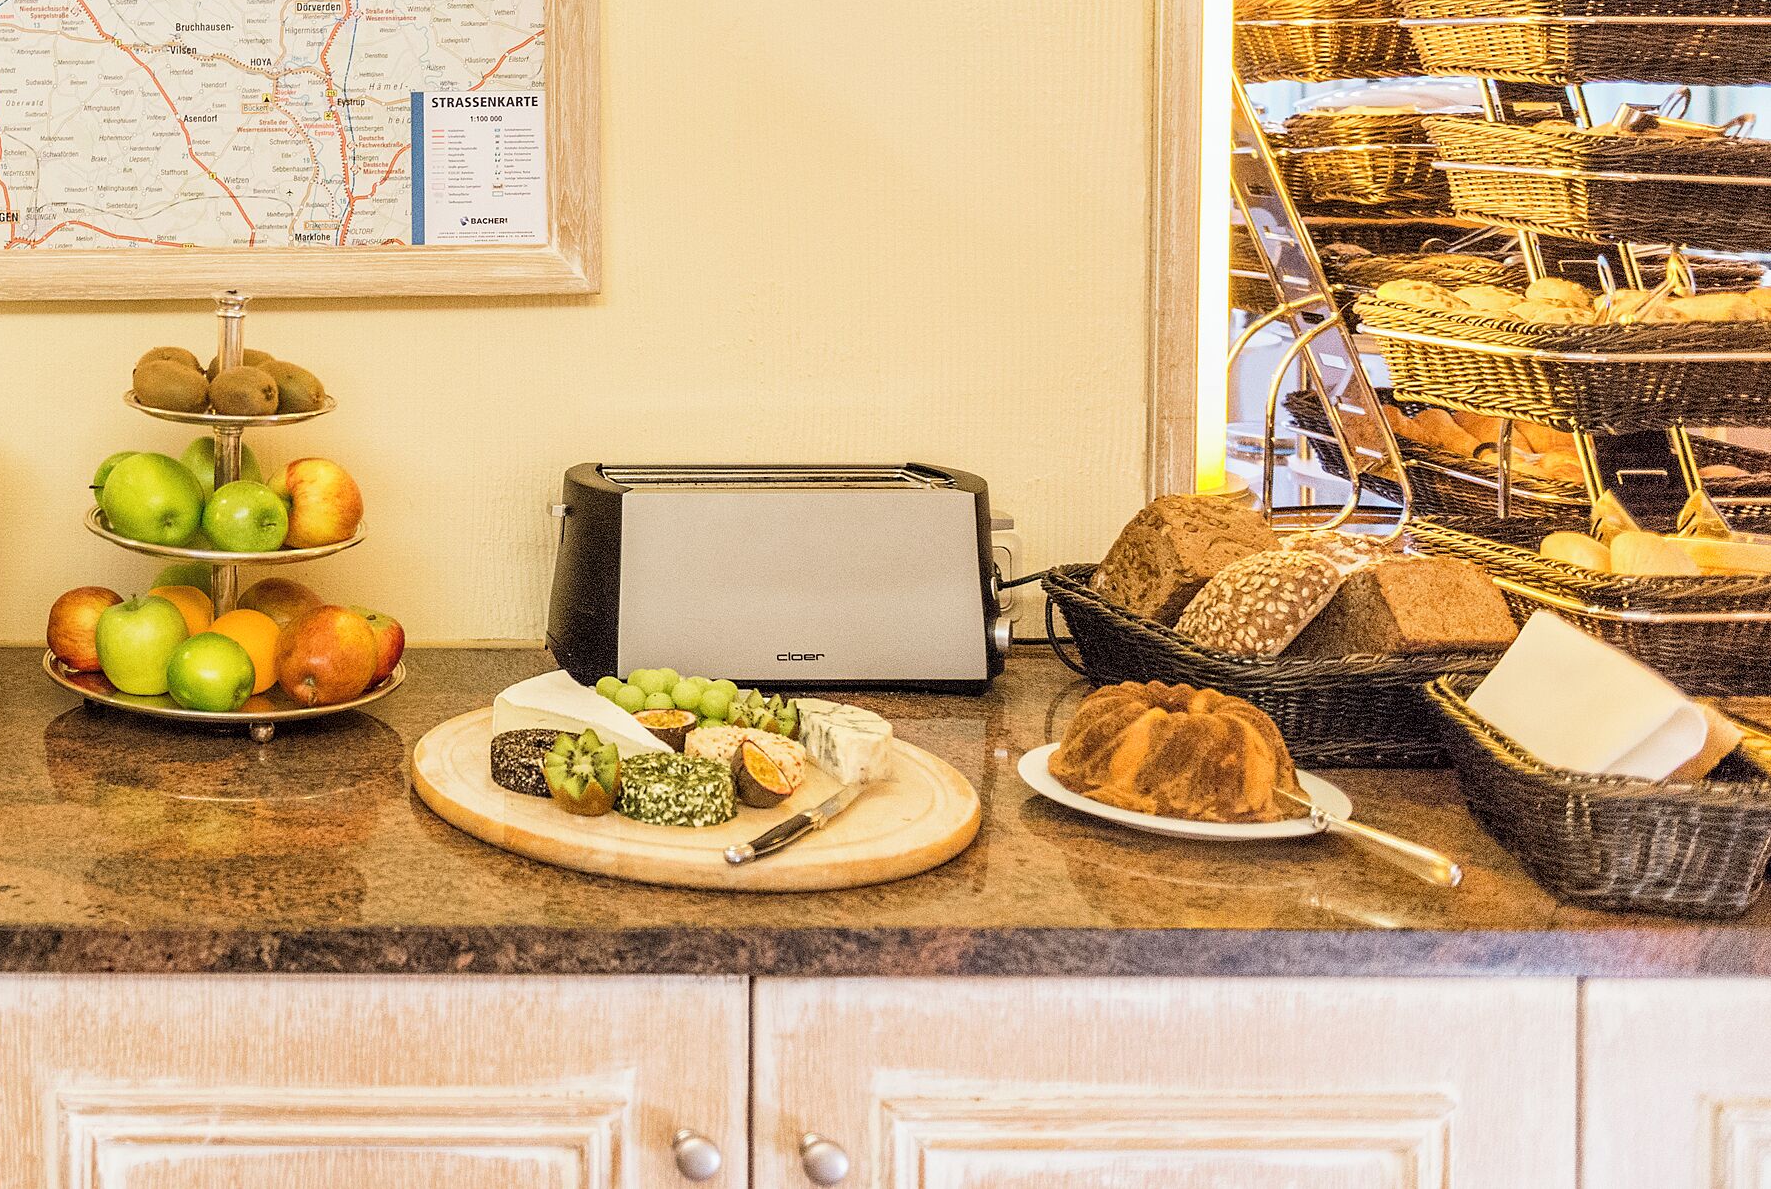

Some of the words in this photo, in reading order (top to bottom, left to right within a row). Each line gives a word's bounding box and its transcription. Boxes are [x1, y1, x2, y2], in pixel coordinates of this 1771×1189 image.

[296, 2, 341, 12] Dörverden
[176, 23, 234, 32] Bruchhausen-
[167, 46, 196, 55] -Vilsen
[250, 58, 271, 66] HOYA
[337, 98, 365, 107] Eystrup
[431, 96, 538, 108] STRASSENKARTE
[184, 115, 217, 123] Asendorf
[776, 652, 825, 662] cloer
